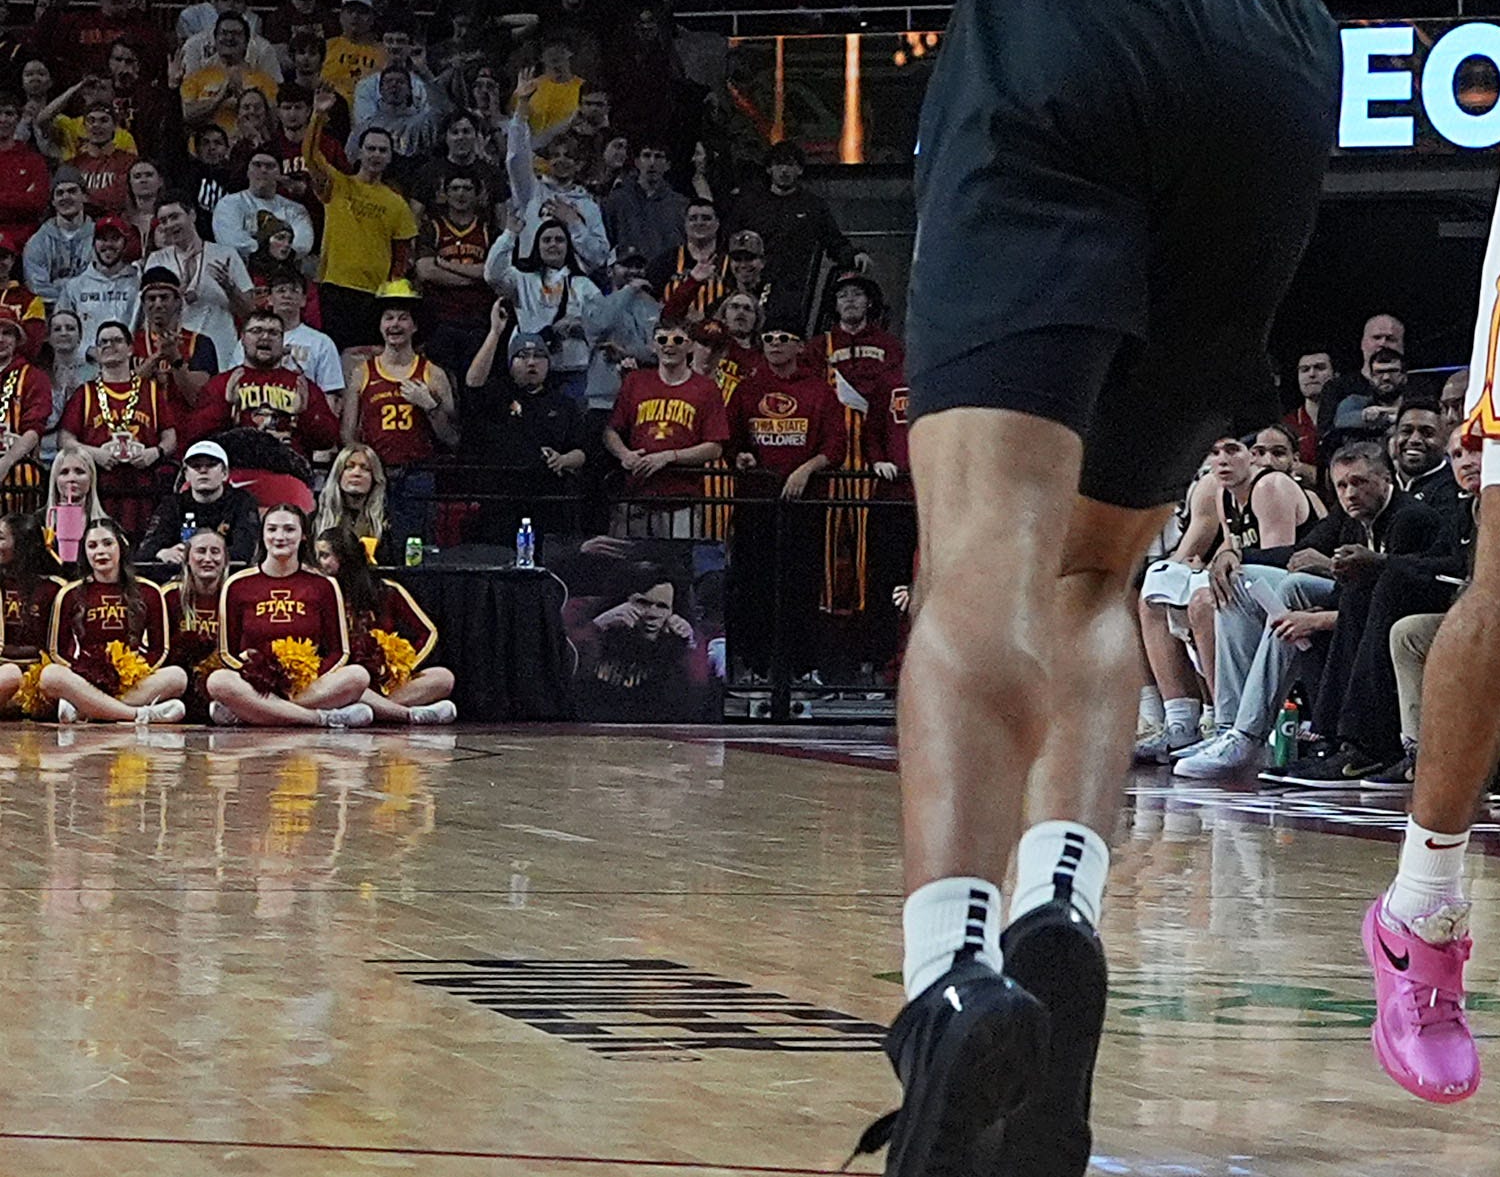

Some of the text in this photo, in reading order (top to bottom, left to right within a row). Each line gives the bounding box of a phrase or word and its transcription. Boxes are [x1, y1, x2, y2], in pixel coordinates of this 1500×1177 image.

[381, 404, 413, 431] 23
[86, 605, 128, 623] STAT
[255, 600, 306, 616] STATE
